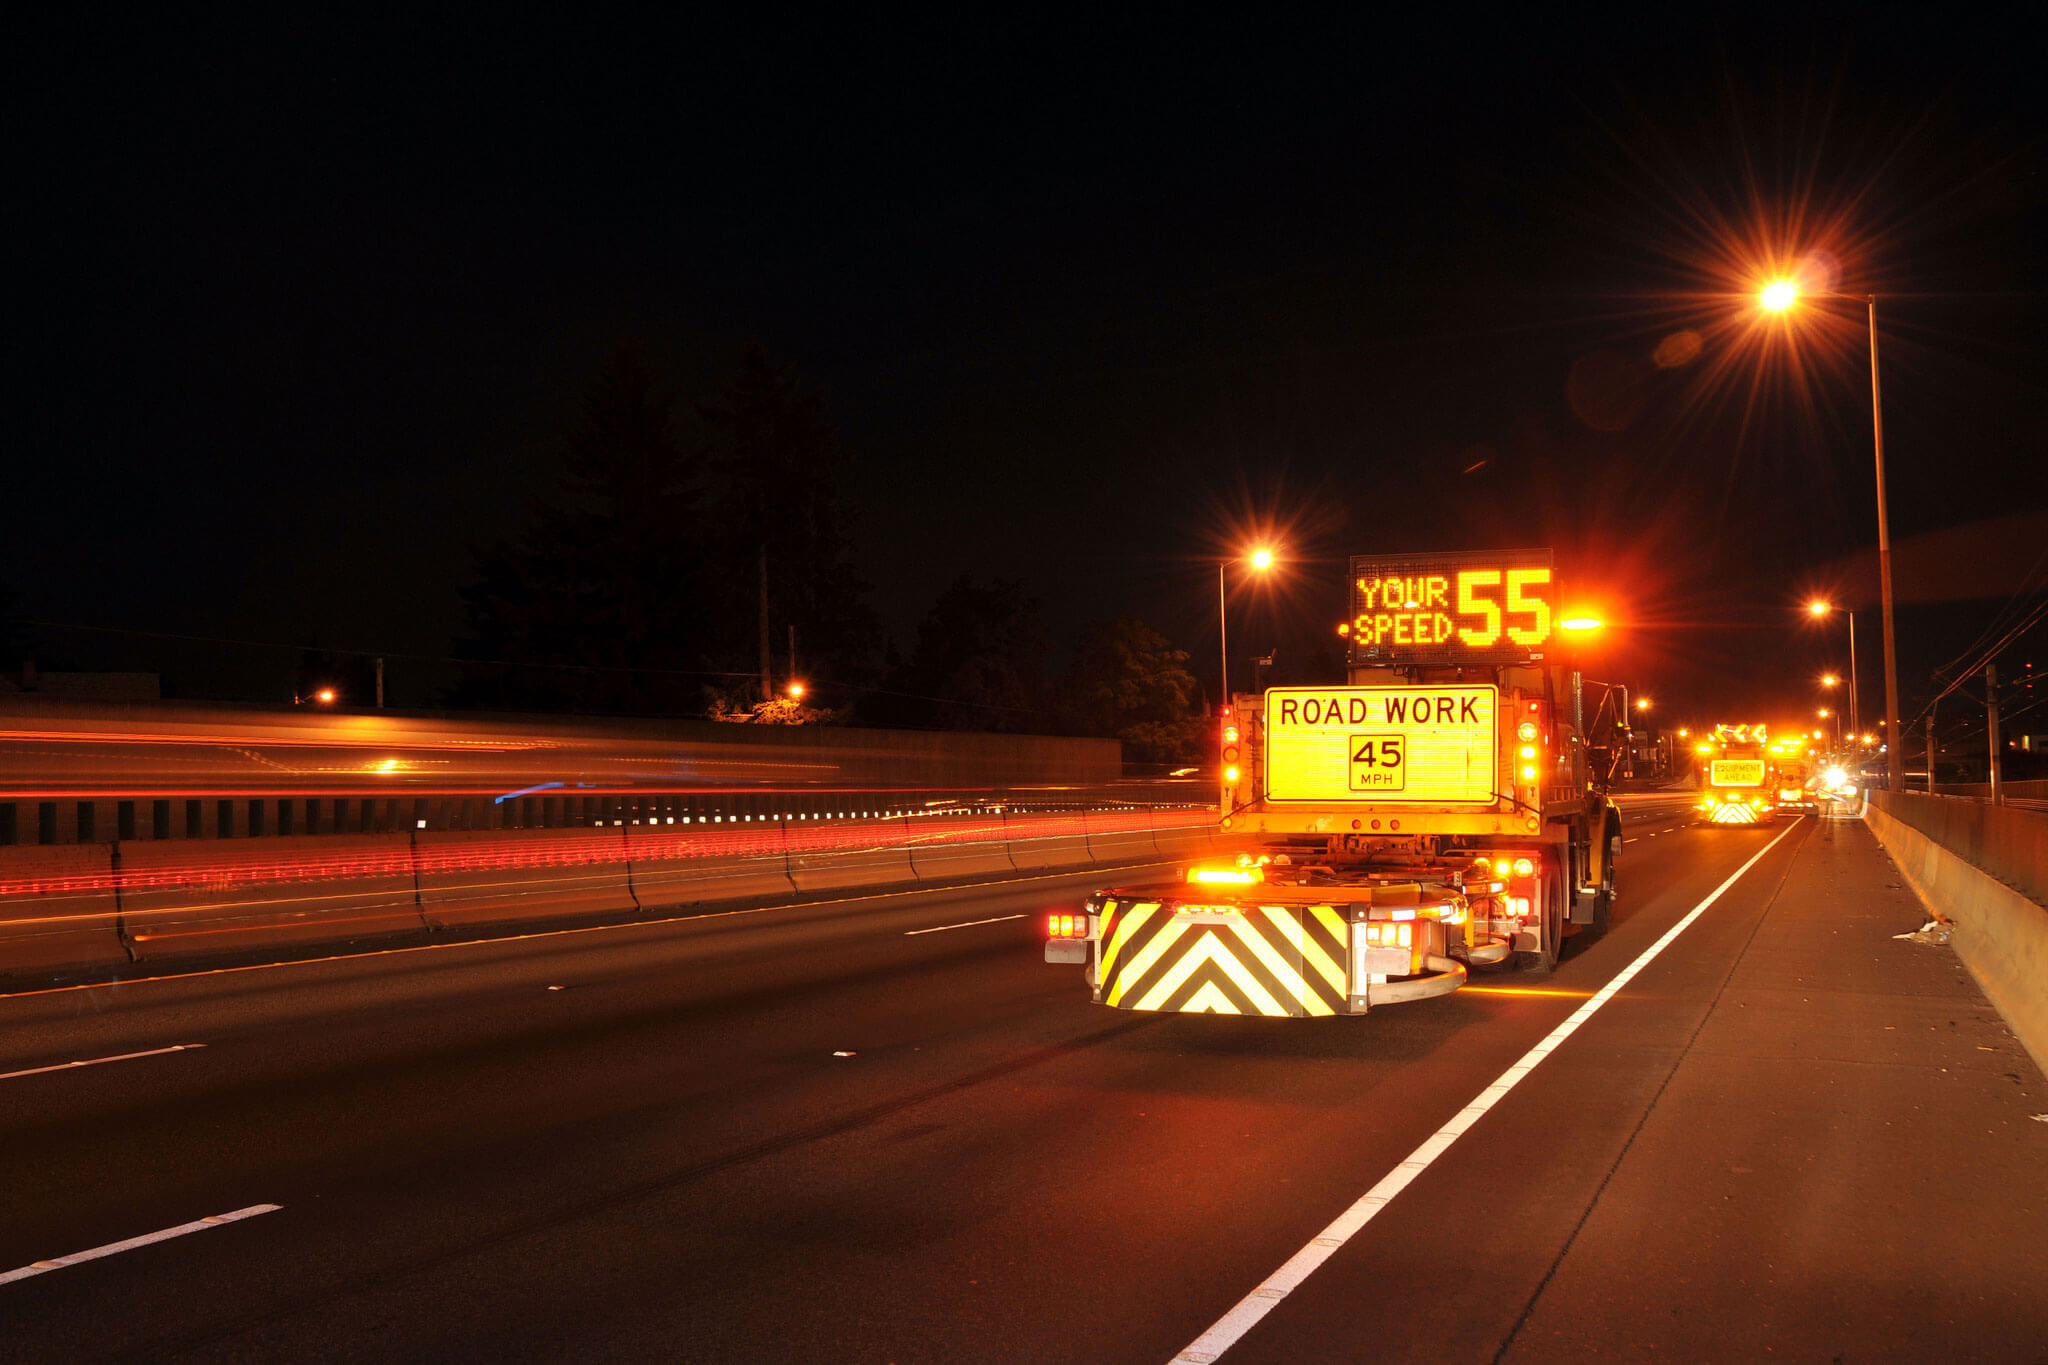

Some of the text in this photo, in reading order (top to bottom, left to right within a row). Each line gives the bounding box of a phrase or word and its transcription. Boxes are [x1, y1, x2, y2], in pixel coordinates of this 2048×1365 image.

[1358, 577, 1448, 608] YOUR
[1458, 569, 1550, 646] 55
[1355, 613, 1452, 644] SPEED
[1281, 696, 1479, 725] ROAD WORK
[1352, 741, 1401, 768] 45
[1714, 764, 1761, 772] EQUIPMENT
[1361, 774, 1393, 785] MPH
[1724, 773, 1753, 781] AHEAD
